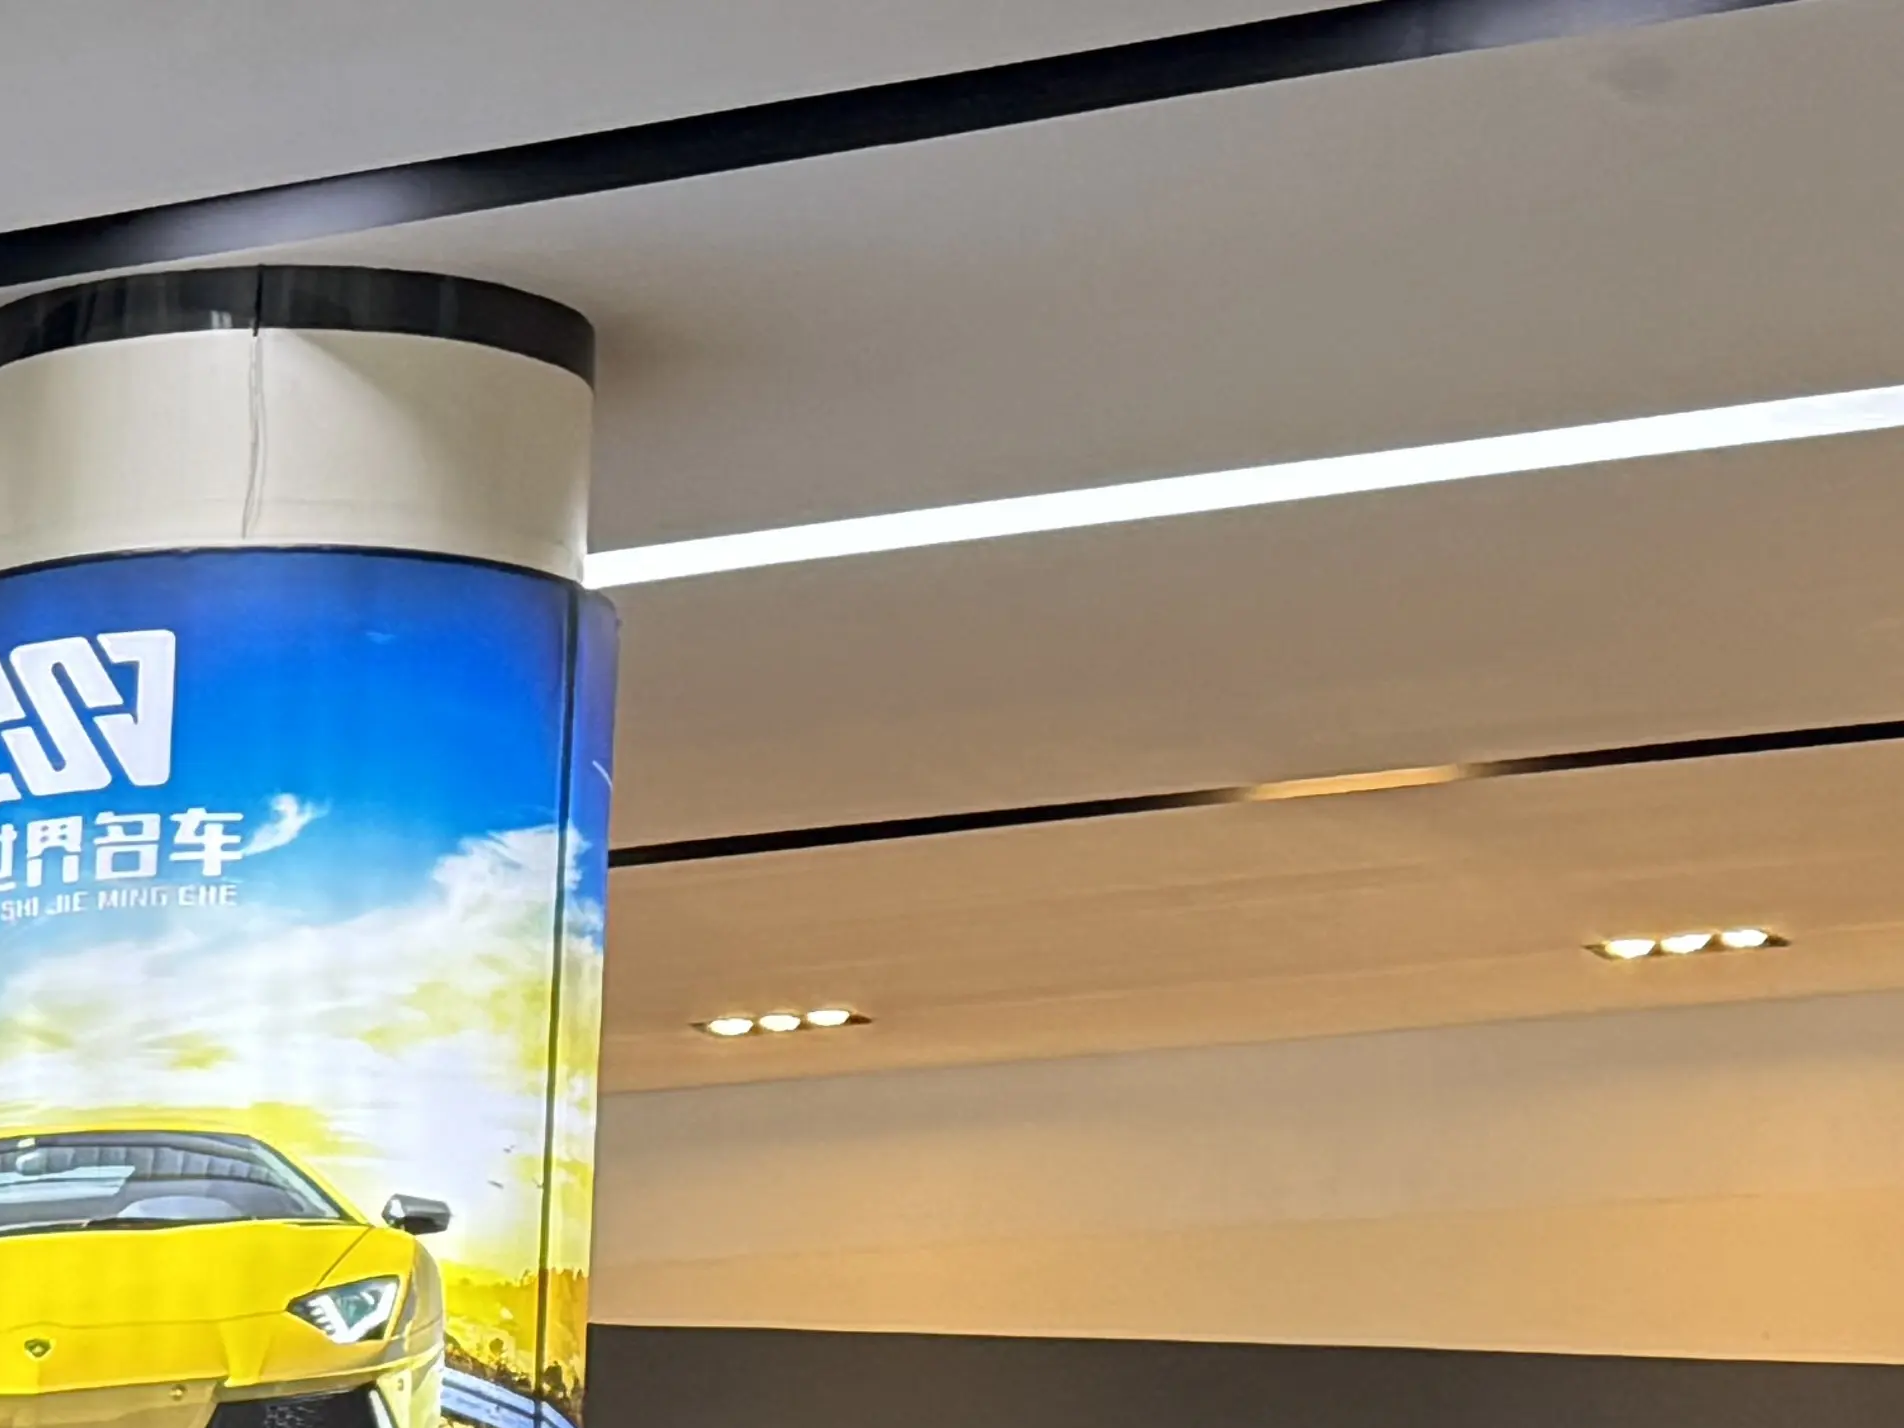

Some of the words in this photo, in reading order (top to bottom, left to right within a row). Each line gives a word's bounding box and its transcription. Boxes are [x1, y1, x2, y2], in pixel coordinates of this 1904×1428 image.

[0, 896, 39, 921] SHI
[45, 891, 90, 916] JIE
[97, 886, 168, 911] MING
